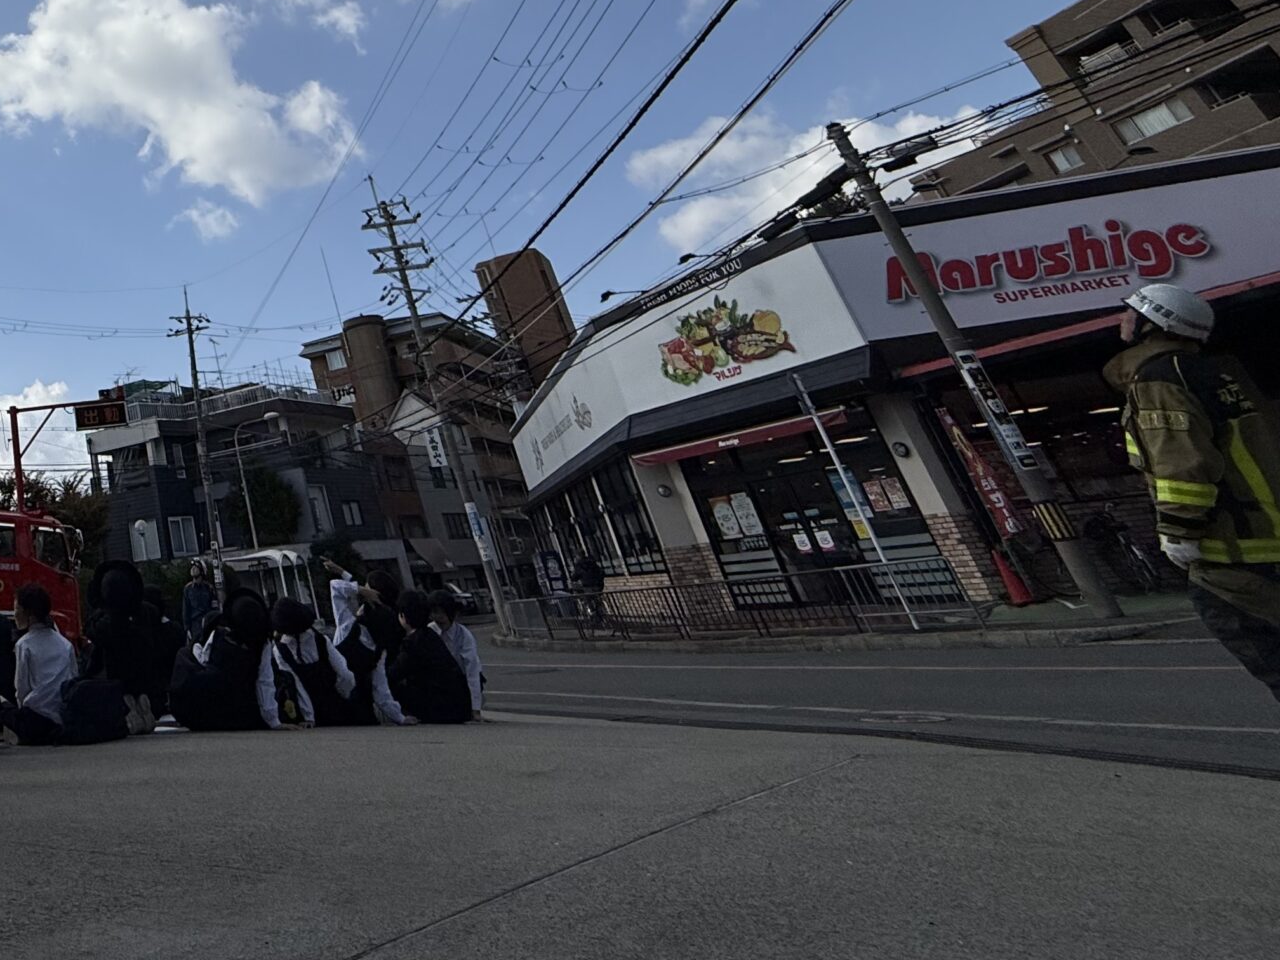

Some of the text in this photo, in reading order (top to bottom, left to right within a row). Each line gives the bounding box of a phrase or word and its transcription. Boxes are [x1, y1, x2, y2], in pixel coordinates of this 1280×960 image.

[721, 258, 742, 275] YOU
[886, 219, 1209, 303] Marushige
[993, 274, 1131, 304] SUPERMARKET
